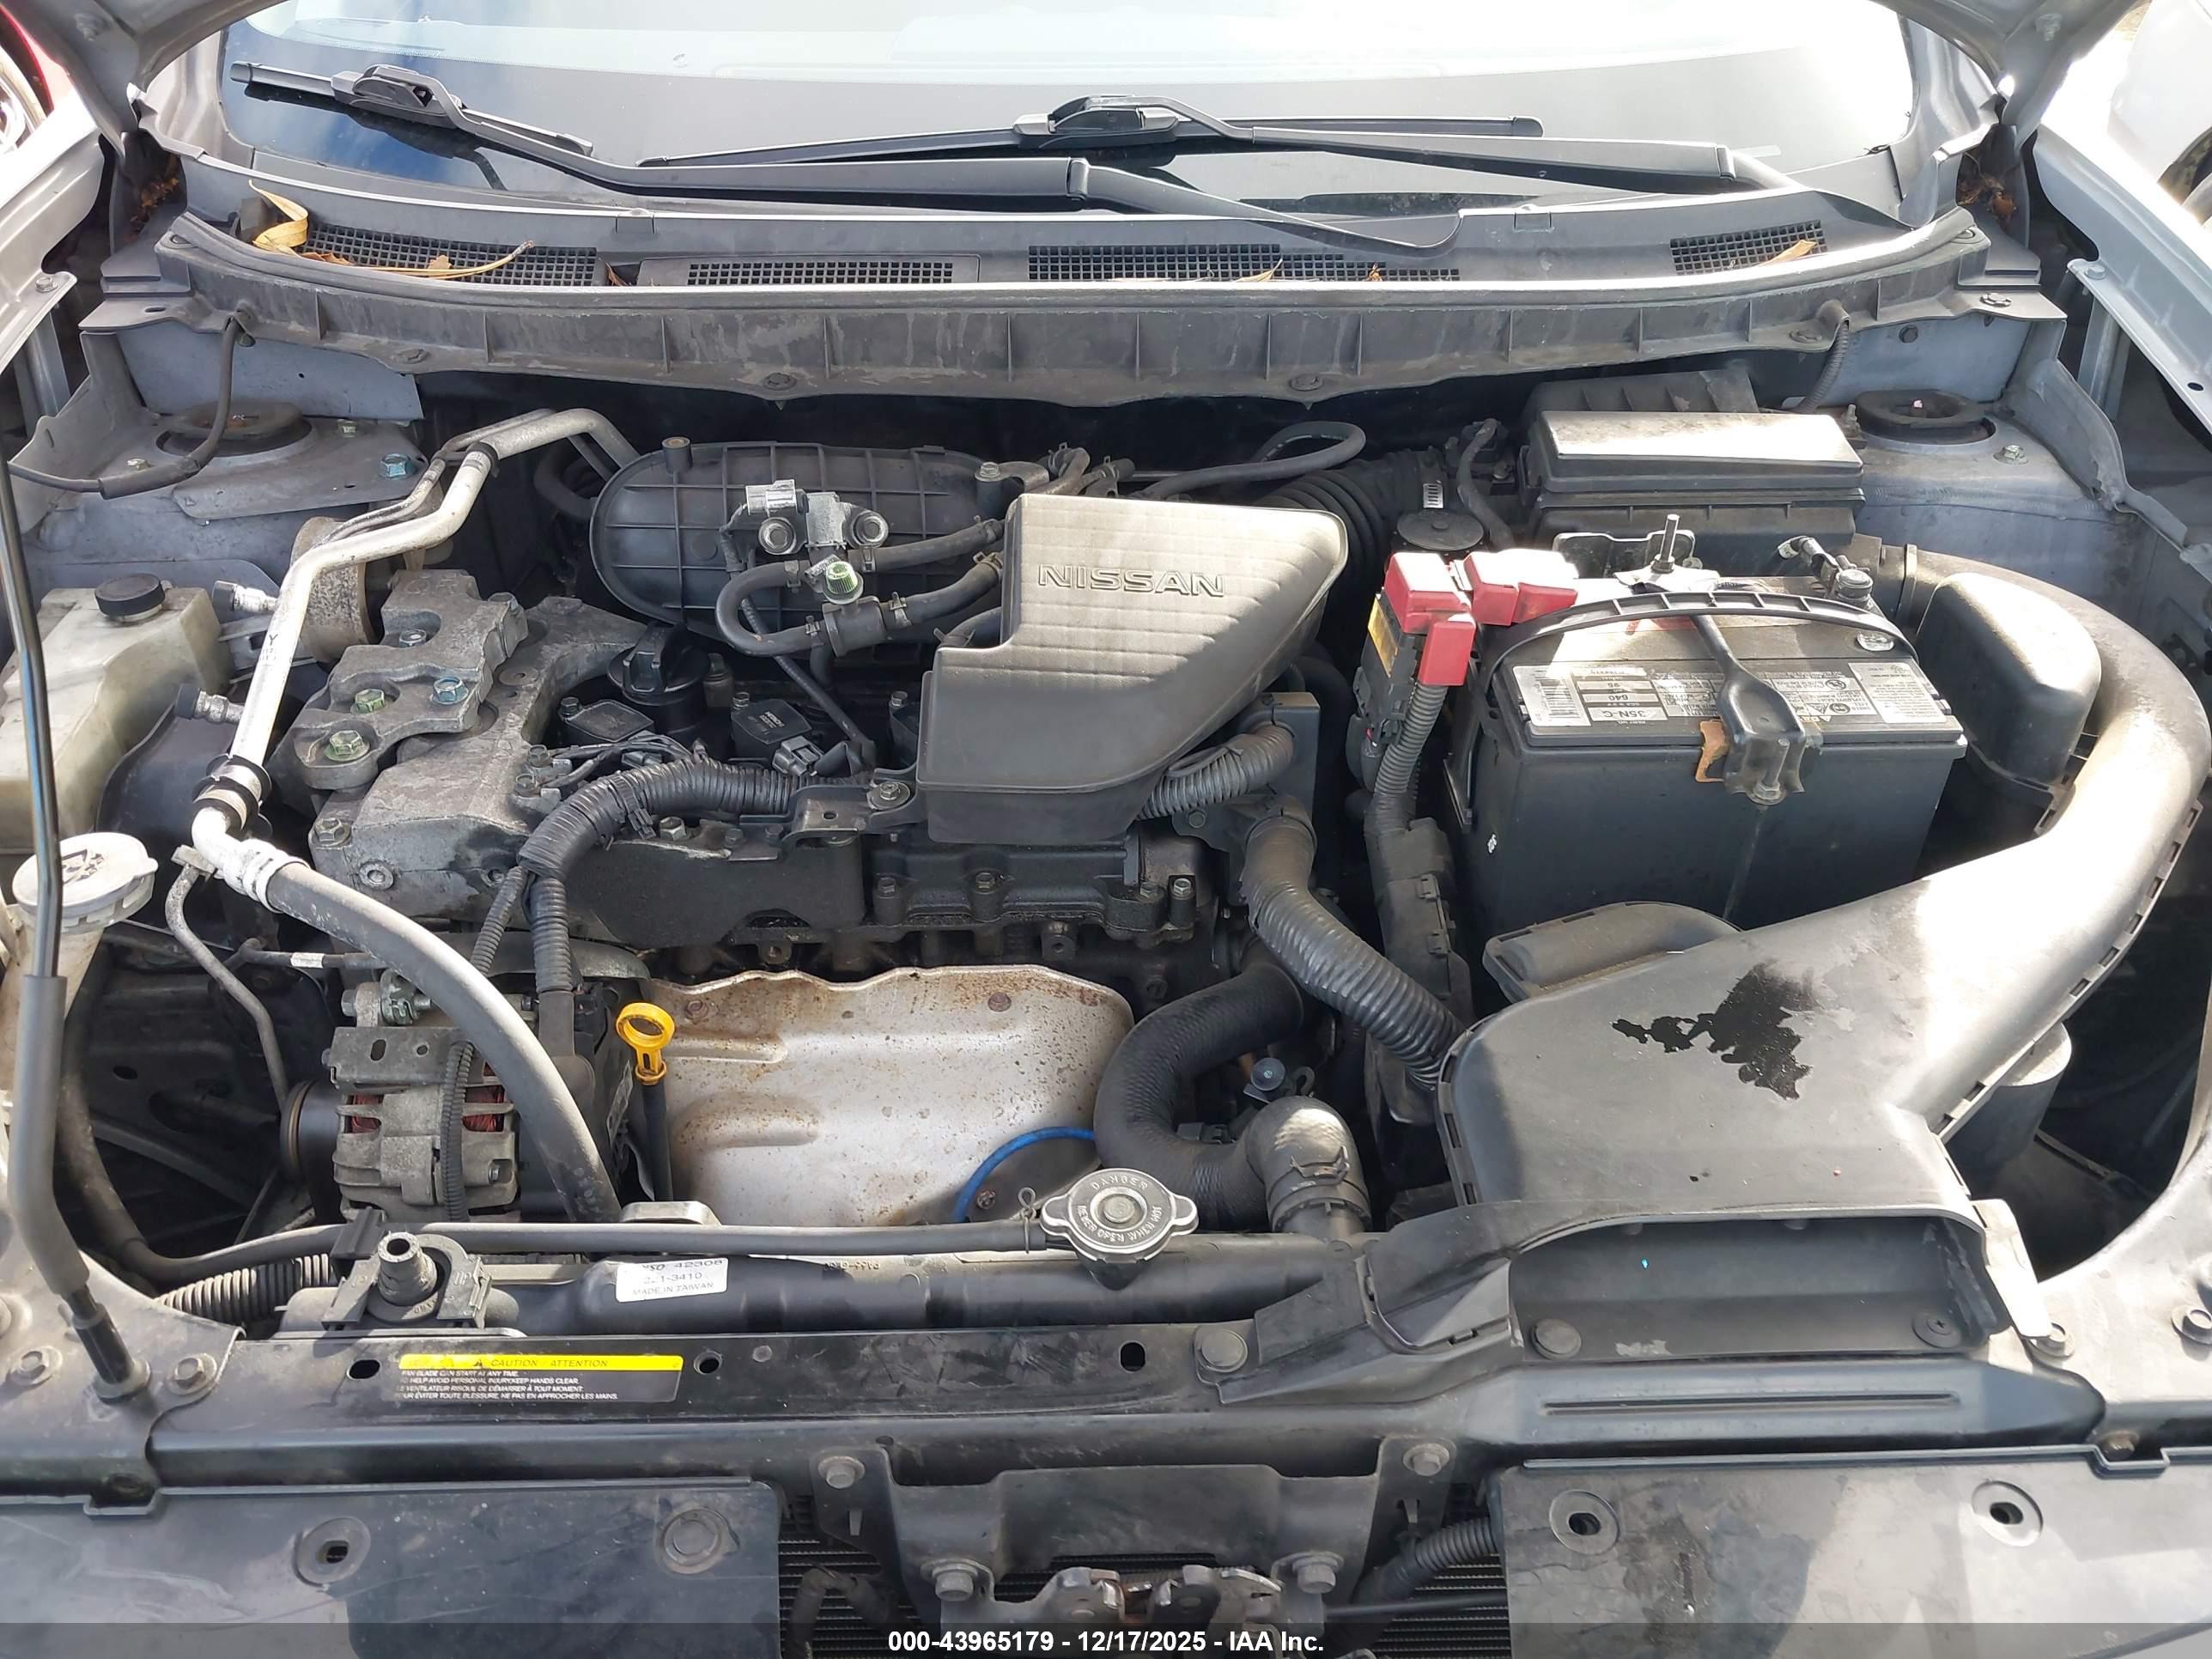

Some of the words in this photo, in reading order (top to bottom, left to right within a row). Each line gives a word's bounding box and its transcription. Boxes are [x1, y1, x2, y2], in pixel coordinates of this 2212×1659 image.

[1038, 563, 1225, 598] NISSAN
[1601, 709, 1646, 718] 35N-C
[1090, 1174, 1148, 1190] DANGER
[676, 1282, 714, 1291] TAIWAN
